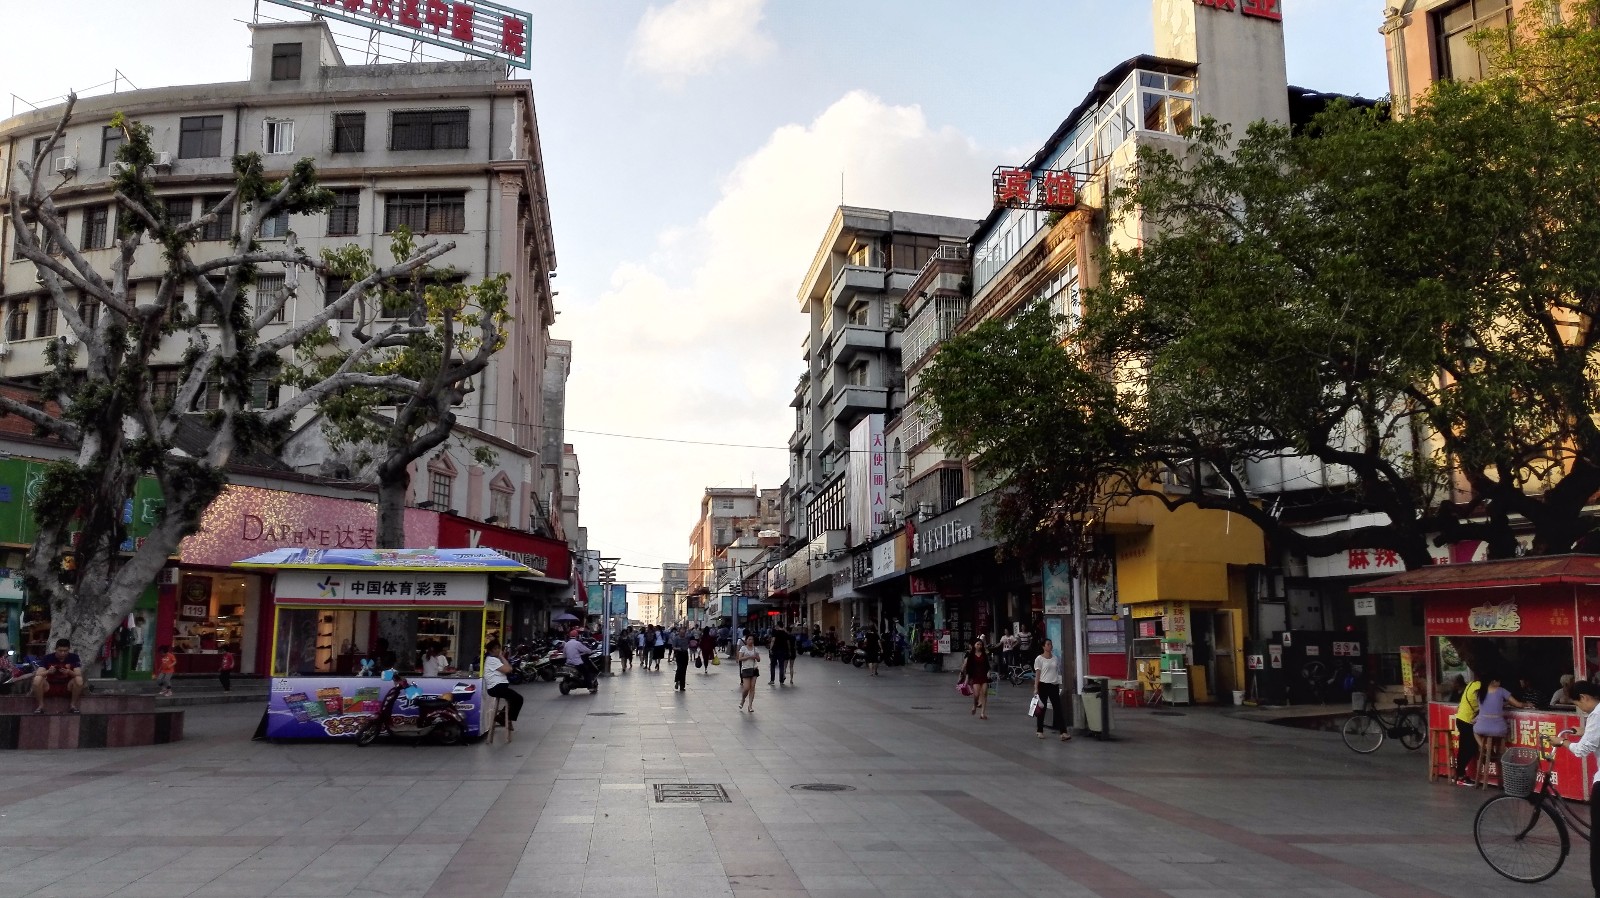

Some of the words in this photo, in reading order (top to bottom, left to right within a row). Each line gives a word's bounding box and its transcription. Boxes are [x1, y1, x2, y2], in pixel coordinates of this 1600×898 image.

[1000, 167, 1076, 205] 宾馆
[241, 514, 330, 546] DAPHNE
[335, 525, 374, 549] 达芙
[351, 581, 447, 596] 中国体育彩票
